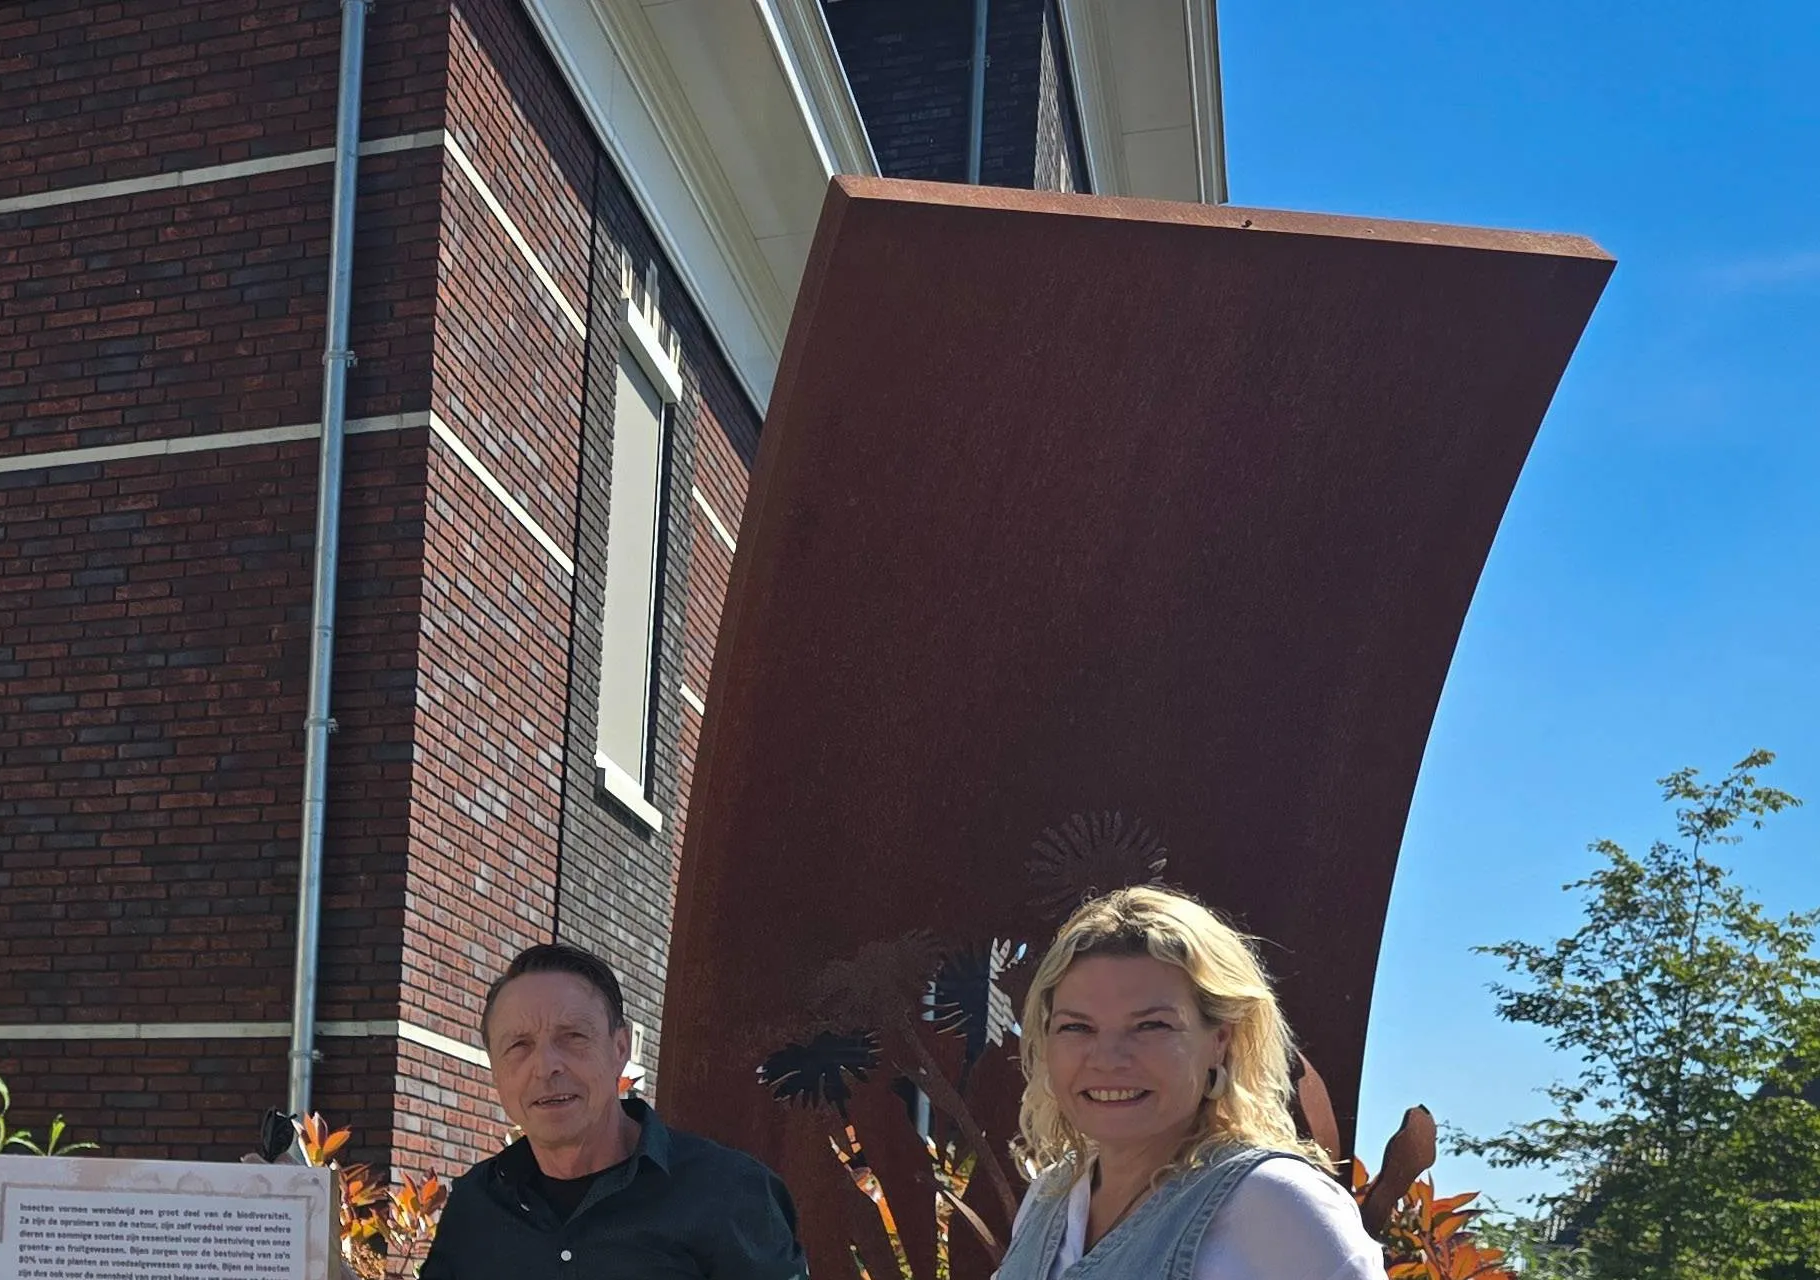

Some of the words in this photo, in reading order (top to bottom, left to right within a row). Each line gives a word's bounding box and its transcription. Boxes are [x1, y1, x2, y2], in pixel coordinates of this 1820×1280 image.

[19, 1203, 55, 1212] Insecten
[91, 1206, 136, 1216] wereldwijd
[158, 1209, 180, 1218] groot
[32, 1217, 46, 1226] zijn
[59, 1218, 100, 1228] opruimers
[160, 1221, 175, 1231] zijn
[176, 1222, 192, 1230] zelf
[193, 1223, 224, 1231] voedsel
[245, 1224, 262, 1232] veel
[264, 1225, 291, 1233] andere
[57, 1232, 92, 1241] sommige
[93, 1233, 124, 1241] soorten
[125, 1233, 140, 1243] zijn
[141, 1234, 182, 1242] essentieel
[213, 1236, 255, 1247] bestuiving
[18, 1243, 53, 1253] groente-
[129, 1246, 150, 1256] Bijen
[152, 1249, 178, 1257] zorgen
[213, 1249, 255, 1260] bestuiving
[274, 1251, 291, 1259] zo'n
[67, 1257, 98, 1267] planten
[111, 1259, 181, 1270] voedselgewassen
[221, 1262, 242, 1272] Bijen
[255, 1264, 290, 1272] insecten
[18, 1269, 32, 1278] zijn
[49, 1270, 64, 1278] ook
[95, 1271, 134, 1280] mensheid
